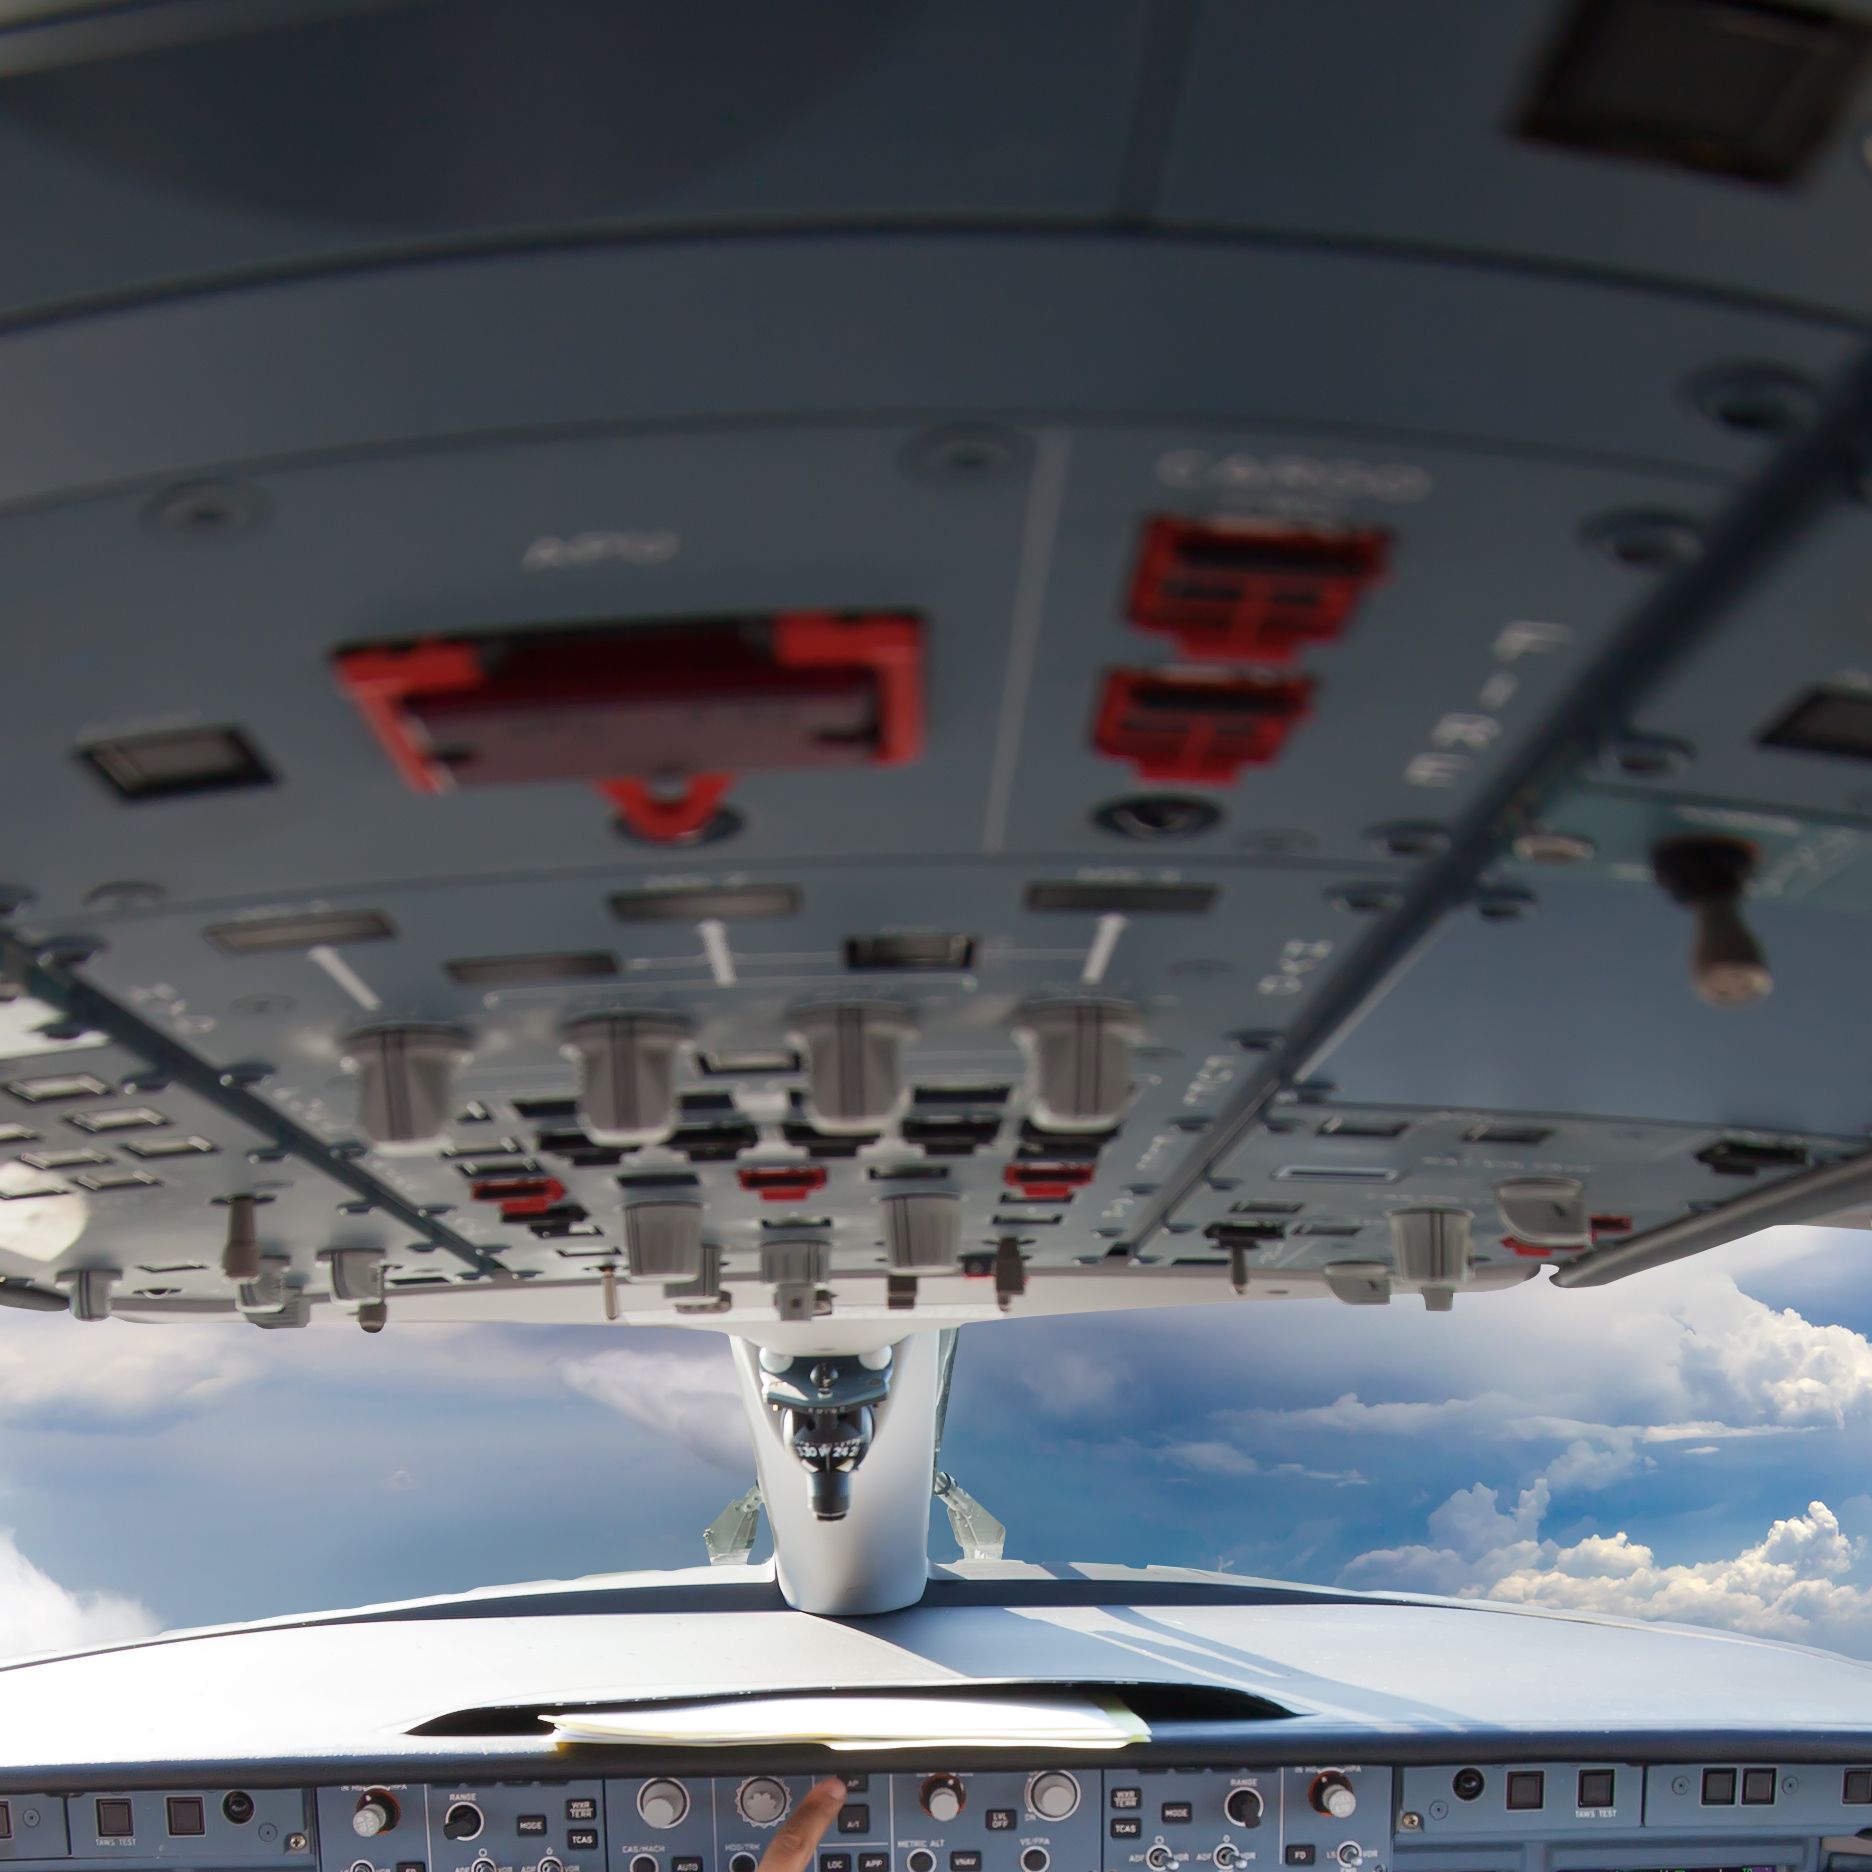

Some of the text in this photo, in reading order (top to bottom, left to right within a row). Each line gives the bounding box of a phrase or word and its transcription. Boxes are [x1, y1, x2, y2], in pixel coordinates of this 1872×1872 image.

[449, 1793, 476, 1801] RANGE
[1166, 1809, 1188, 1817] MODE
[572, 1836, 592, 1844] TCAS
[897, 1840, 926, 1848] METRIC
[677, 1863, 698, 1871] AUTO
[828, 1860, 843, 1868] LOC
[866, 1860, 882, 1868] APP
